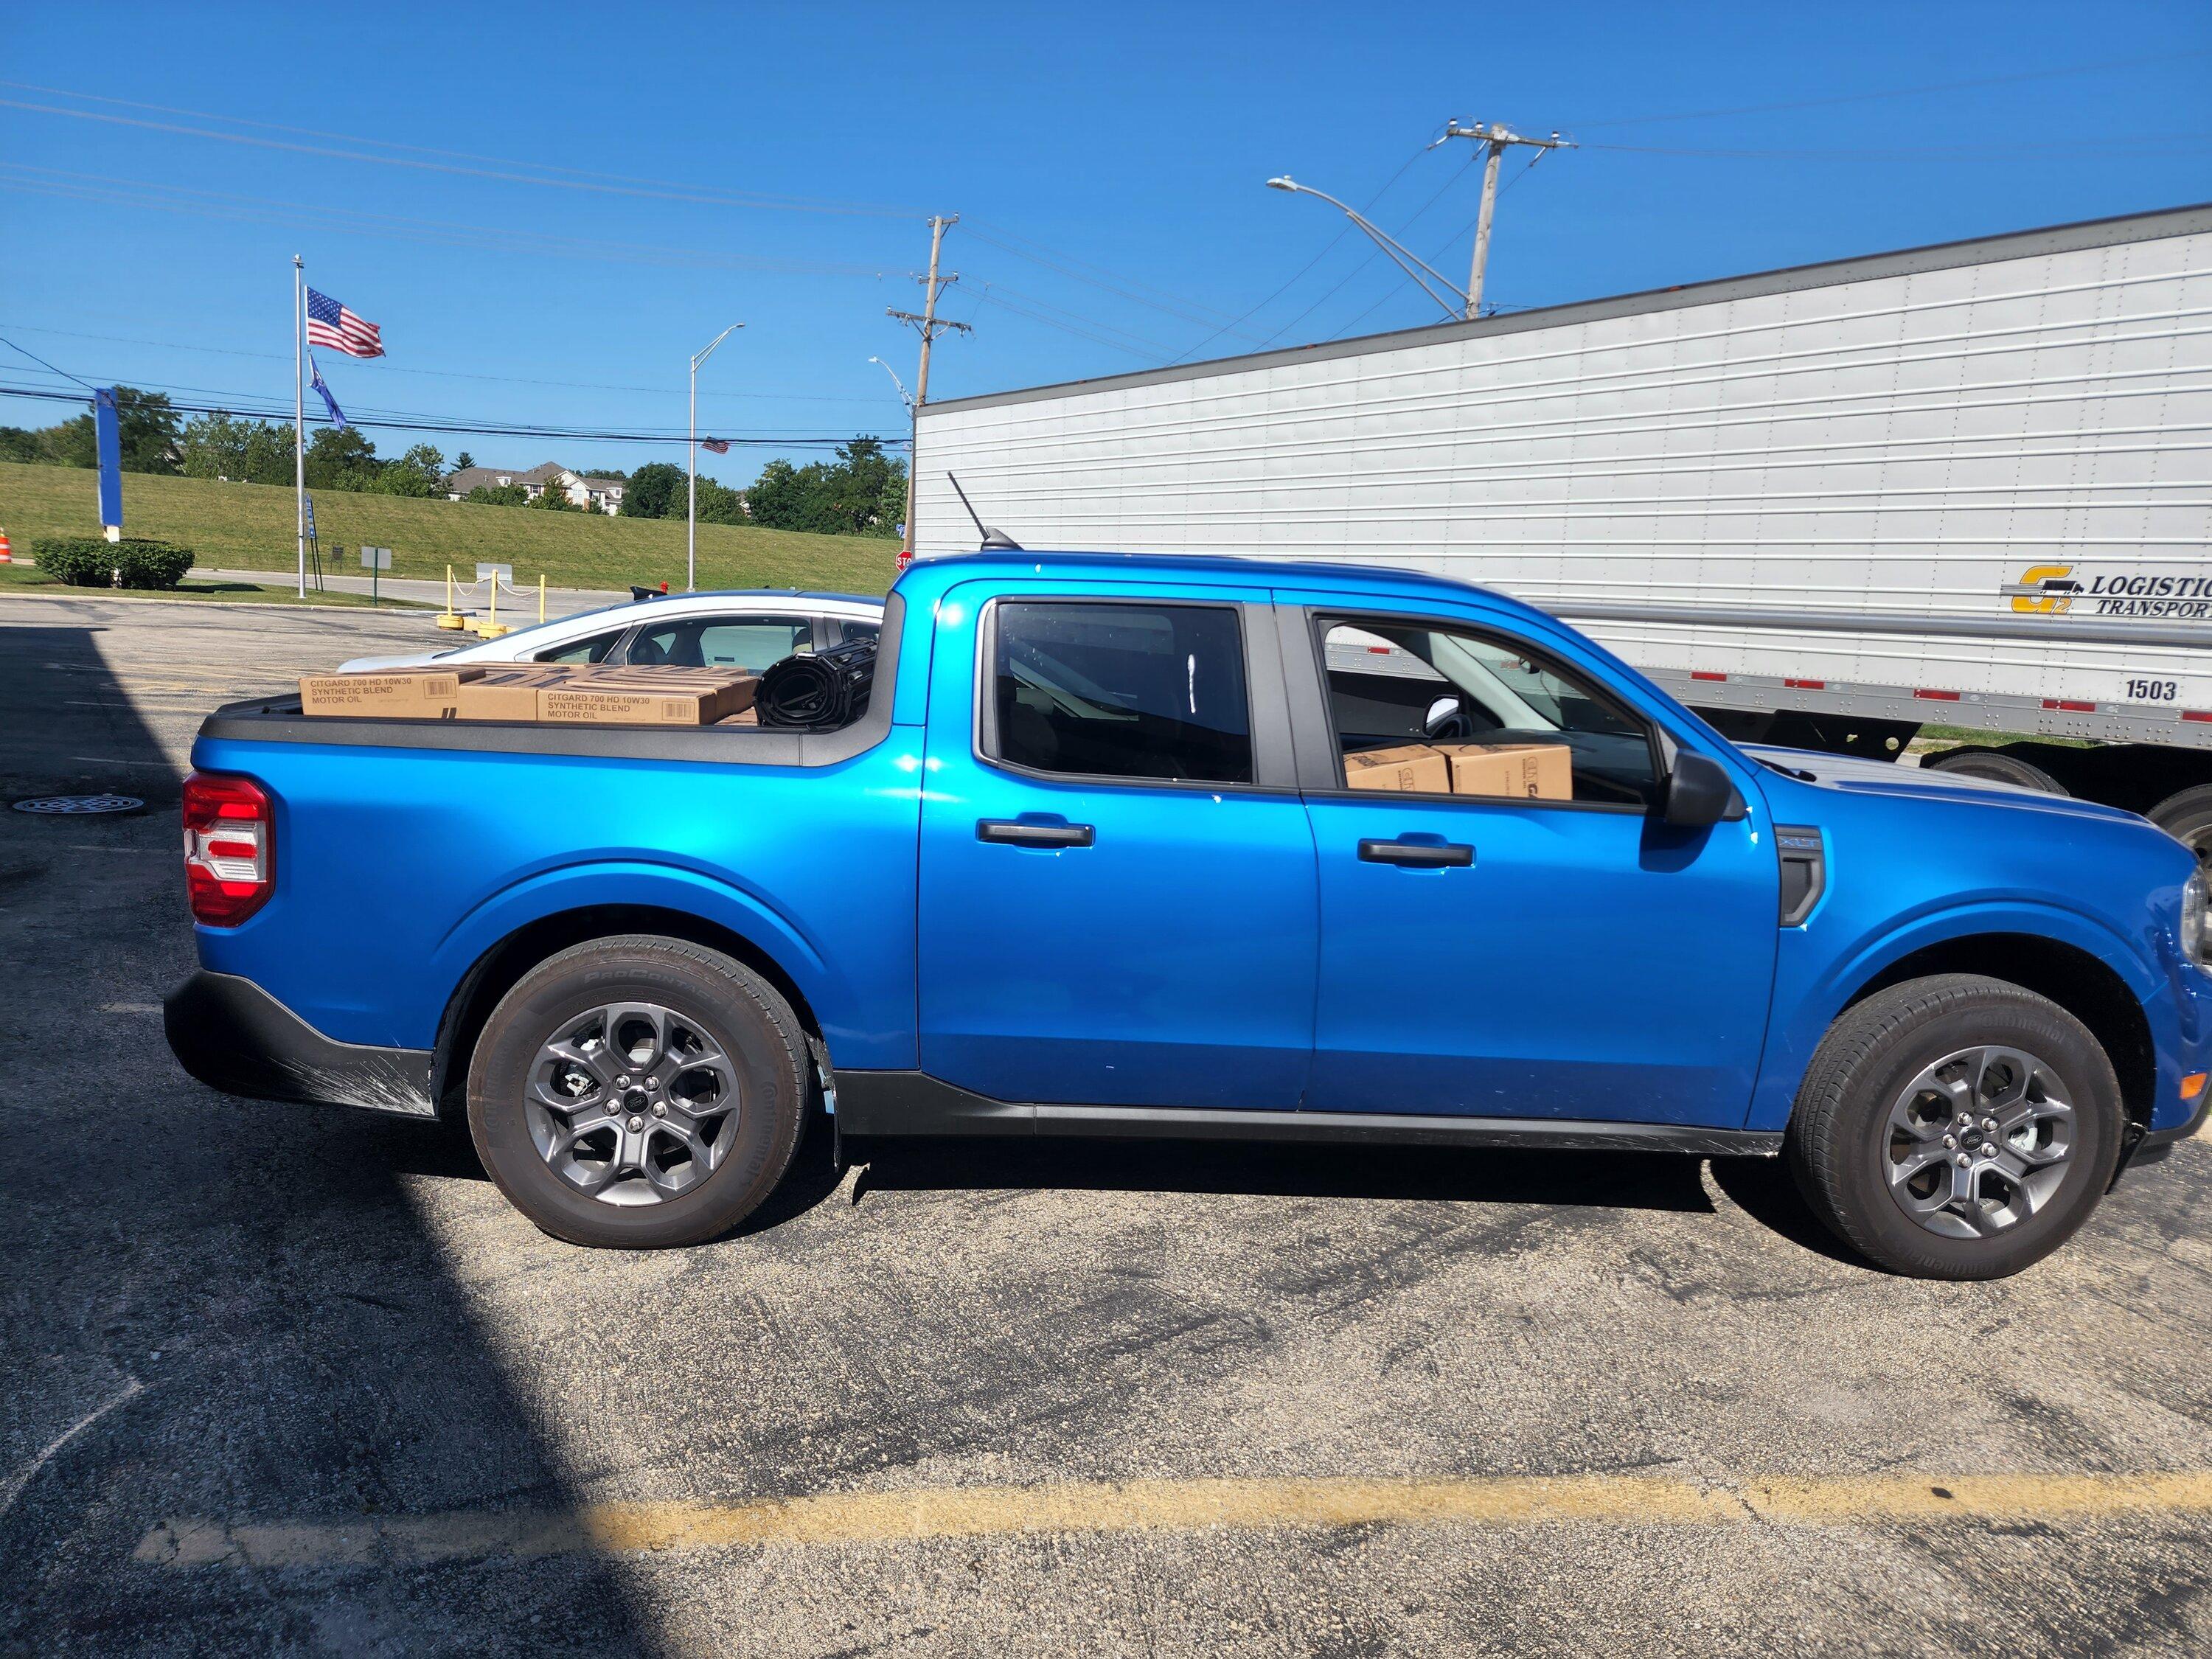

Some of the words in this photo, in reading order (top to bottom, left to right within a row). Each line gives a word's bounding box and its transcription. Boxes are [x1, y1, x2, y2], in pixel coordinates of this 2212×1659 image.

[897, 557, 912, 566] STO
[2096, 599, 2212, 618] TRANSPOR
[312, 687, 361, 695] SYNTHETIC
[2126, 679, 2177, 701] 1503
[547, 693, 588, 702] CITGARD
[548, 702, 597, 711] SYNTHETIC
[600, 704, 630, 712] BLEND
[547, 710, 580, 718] MOTOR
[1778, 836, 1820, 847] XLT
